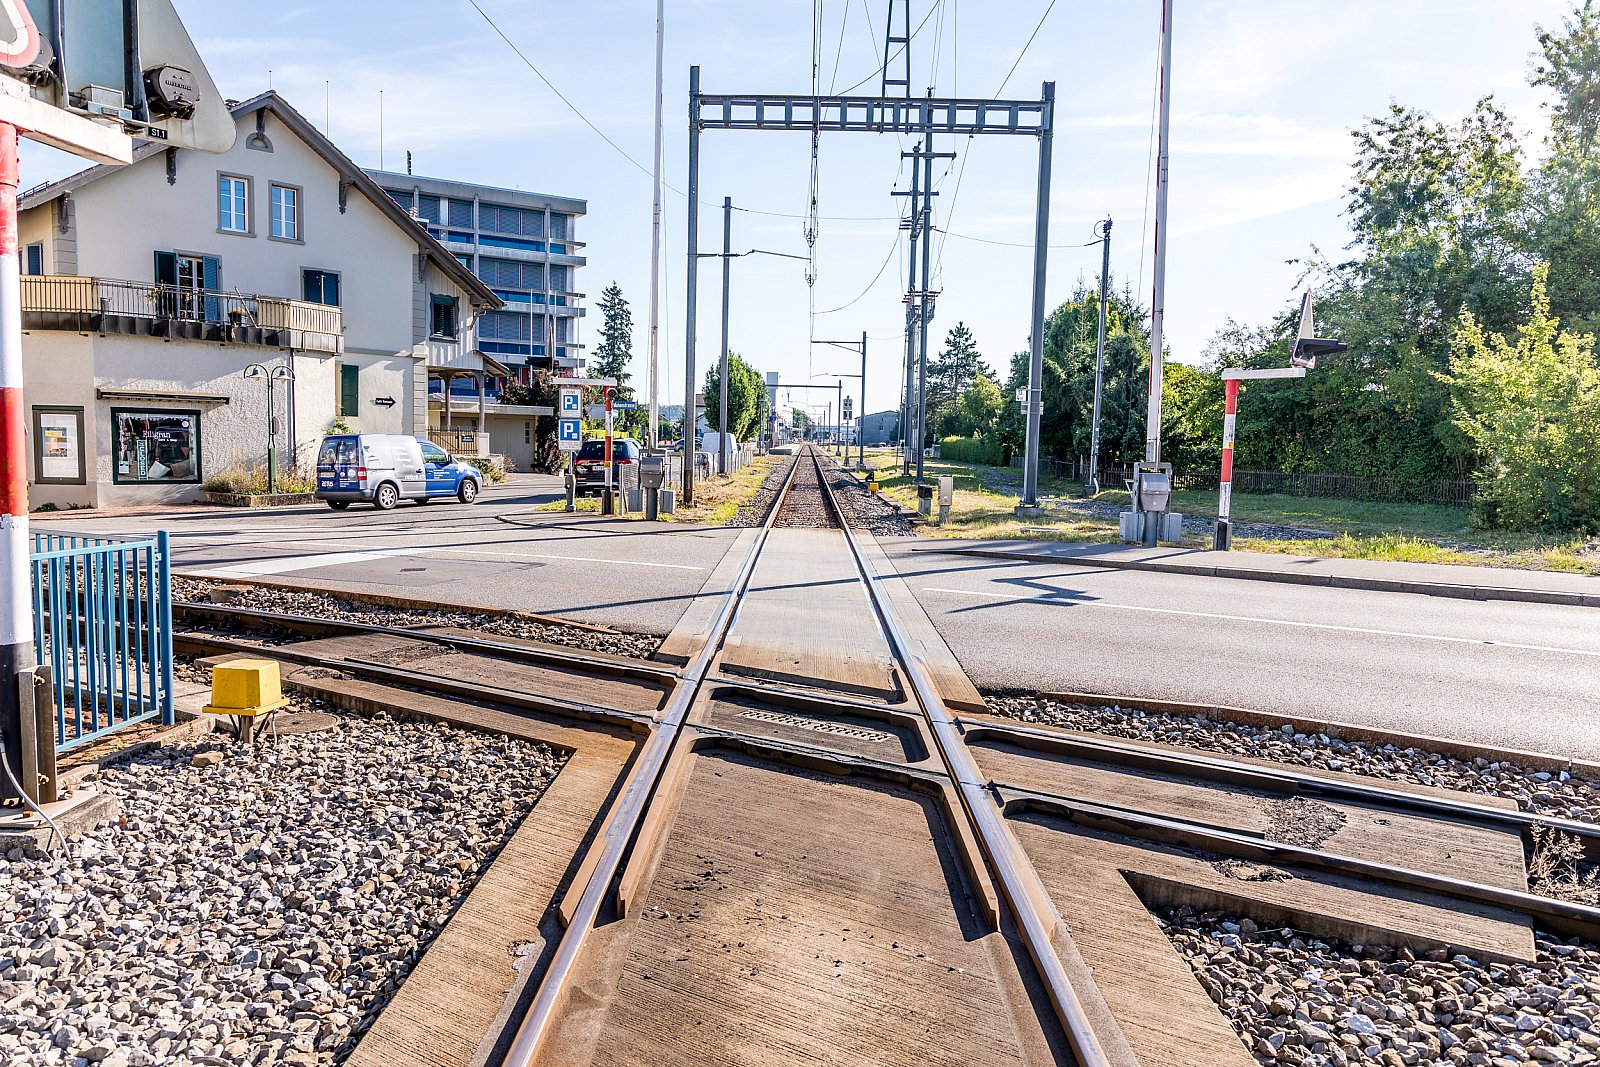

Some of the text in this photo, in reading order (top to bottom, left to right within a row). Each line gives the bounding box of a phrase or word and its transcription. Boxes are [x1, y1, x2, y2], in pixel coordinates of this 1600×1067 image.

[151, 128, 165, 138] S1.1
[565, 396, 573, 409] P
[564, 423, 574, 438] P
